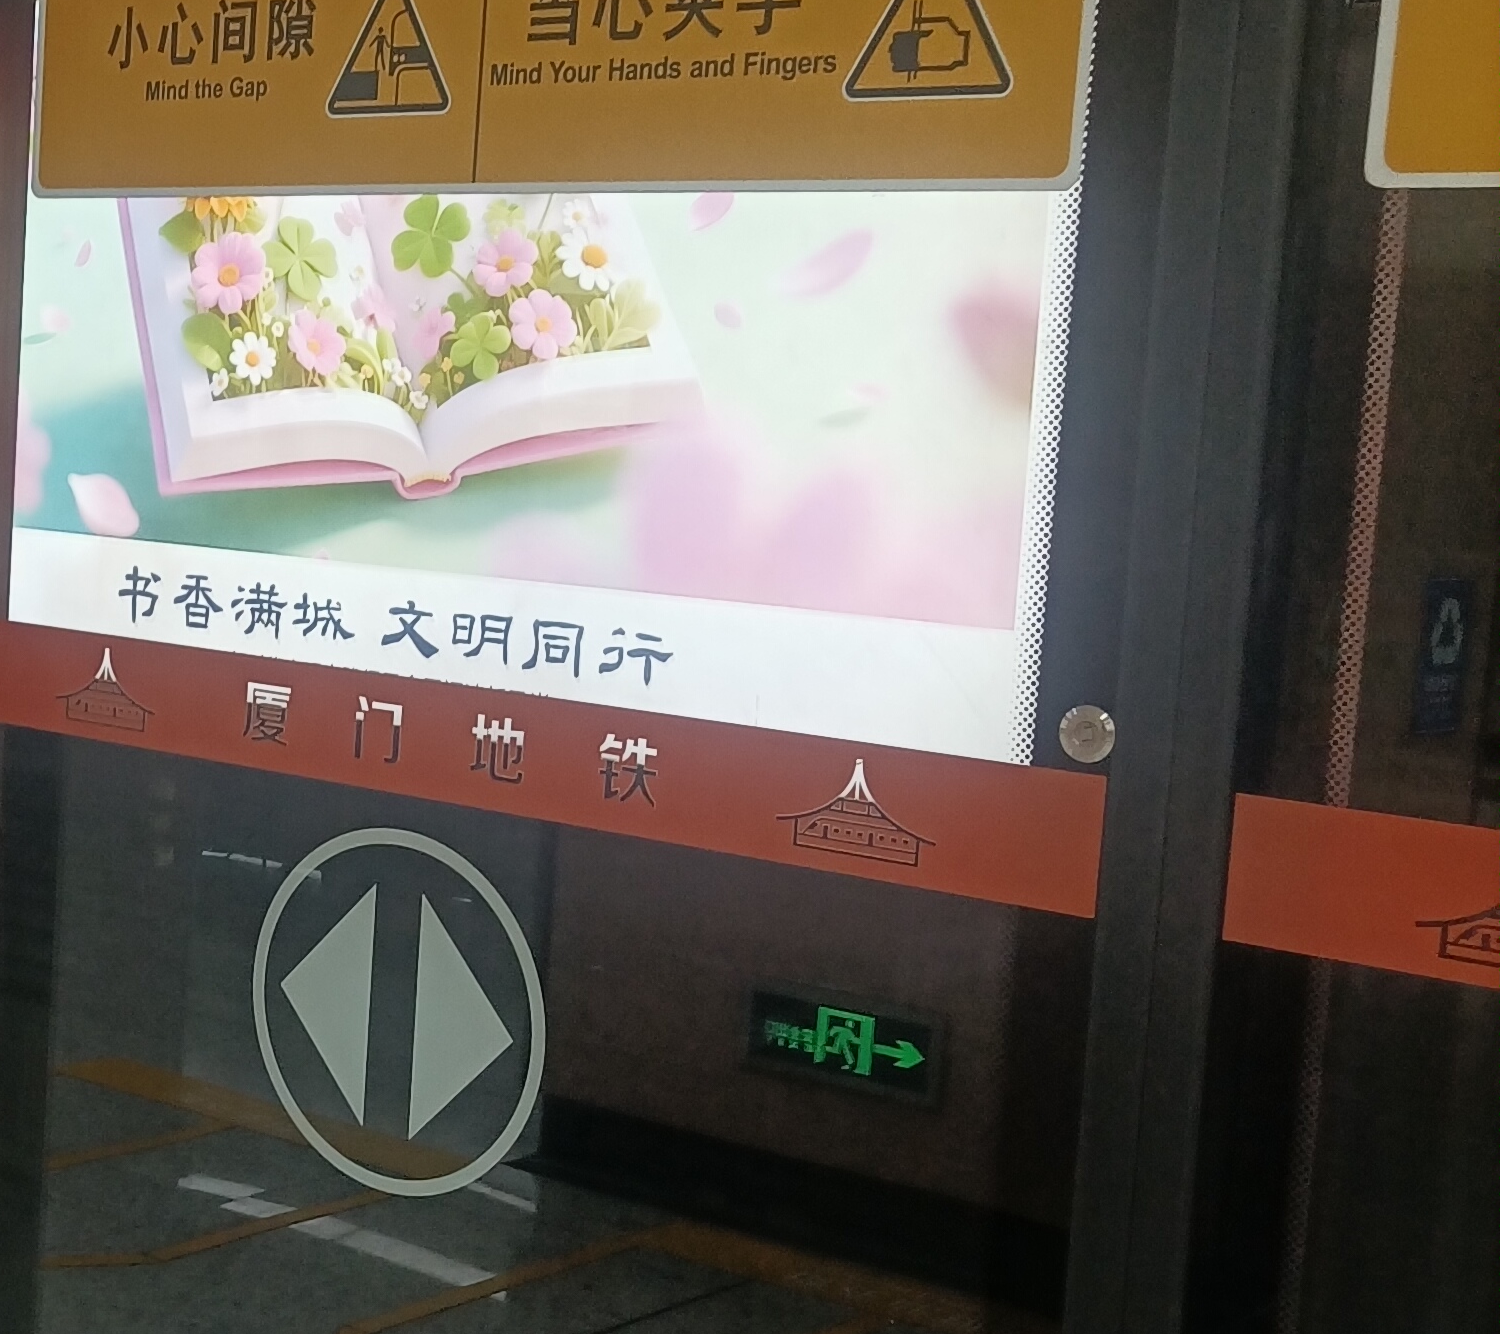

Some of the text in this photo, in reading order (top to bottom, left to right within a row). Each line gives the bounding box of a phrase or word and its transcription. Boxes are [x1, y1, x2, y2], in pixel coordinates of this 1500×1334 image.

[146, 76, 268, 101] Mind the Gap
[490, 51, 837, 86] Mind Your Hands and Fingers
[118, 565, 674, 686] 书香满城 文明同行
[243, 681, 659, 808] 厦门地铁
